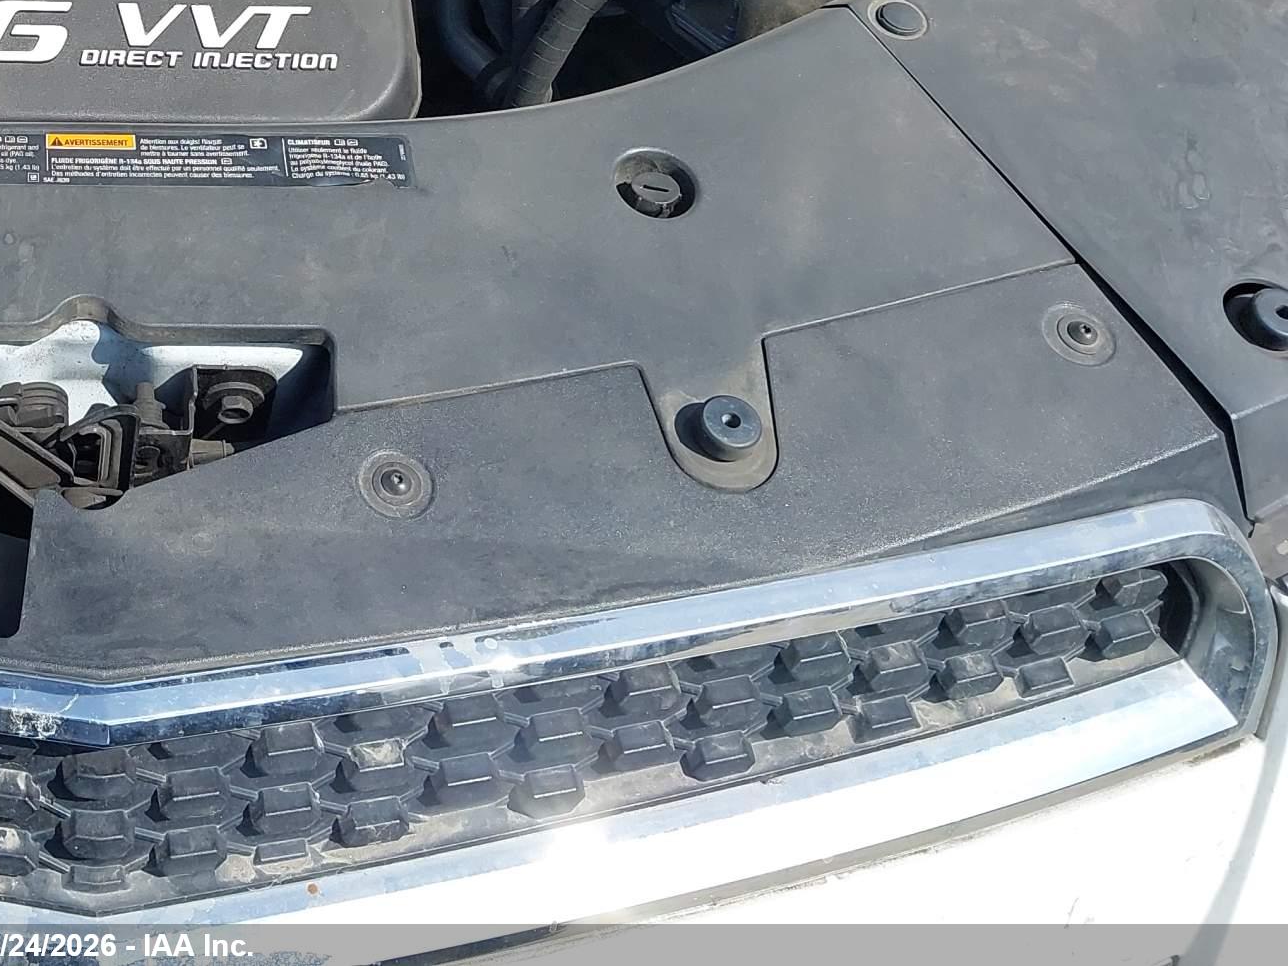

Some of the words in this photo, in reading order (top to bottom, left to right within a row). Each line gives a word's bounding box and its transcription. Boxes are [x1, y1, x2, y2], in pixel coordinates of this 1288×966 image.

[116, 2, 312, 51] VVT
[78, 49, 184, 68] DIRECT
[192, 51, 338, 71] INJECTION
